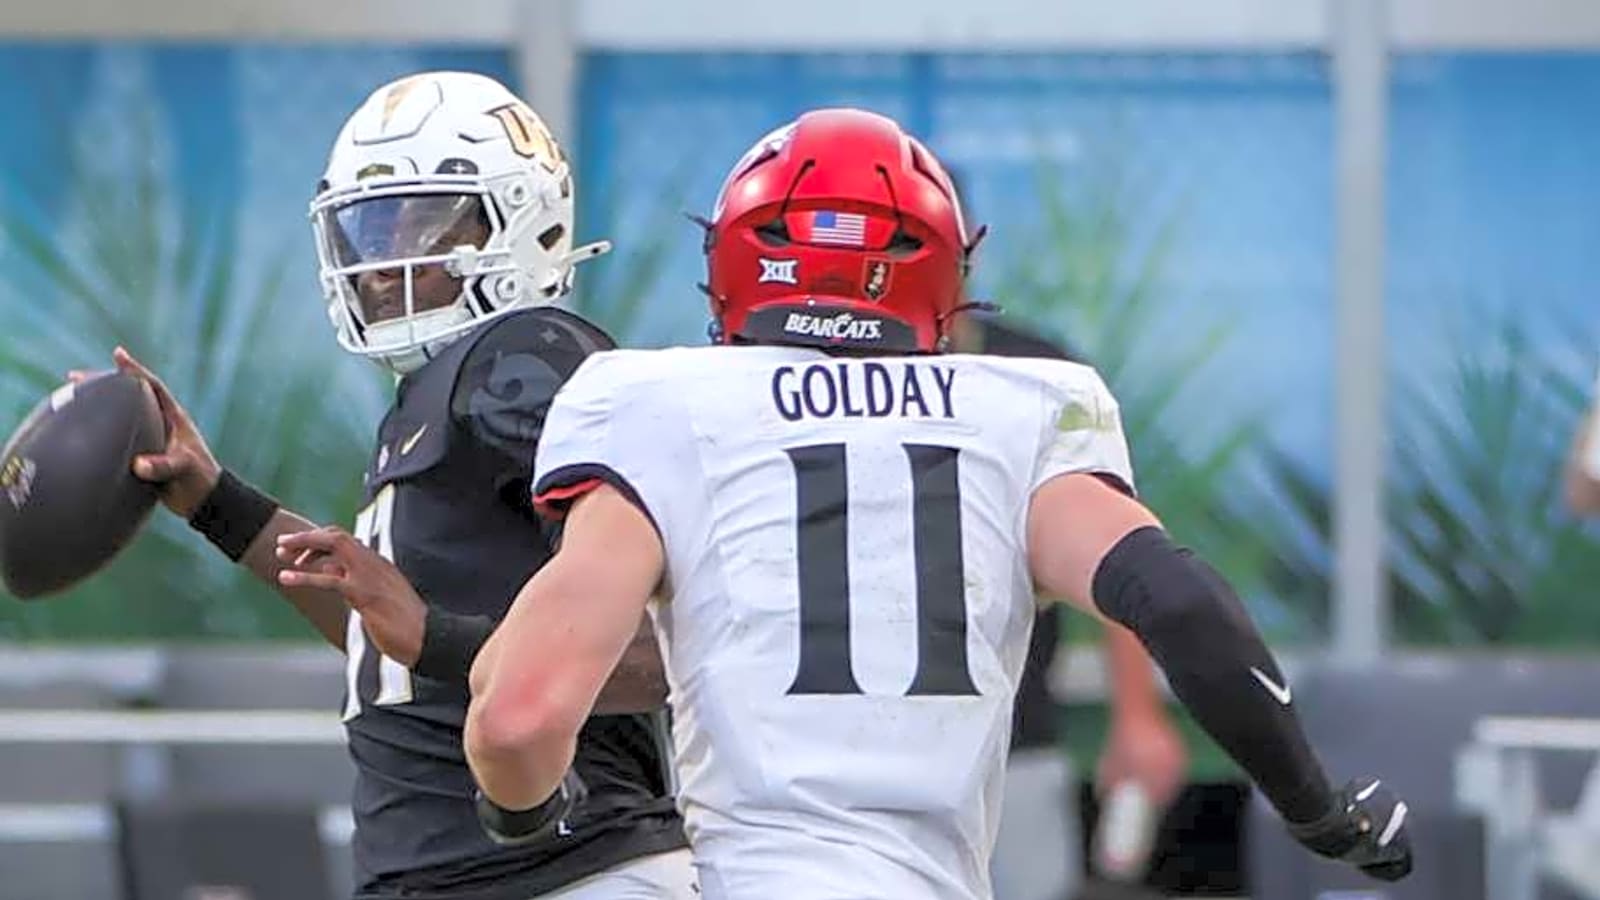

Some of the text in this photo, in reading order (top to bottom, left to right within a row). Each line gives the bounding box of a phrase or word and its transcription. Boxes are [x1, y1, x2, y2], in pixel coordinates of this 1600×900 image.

[758, 258, 798, 284] XII
[771, 362, 956, 421] GOLDAY
[781, 442, 984, 697] 11
